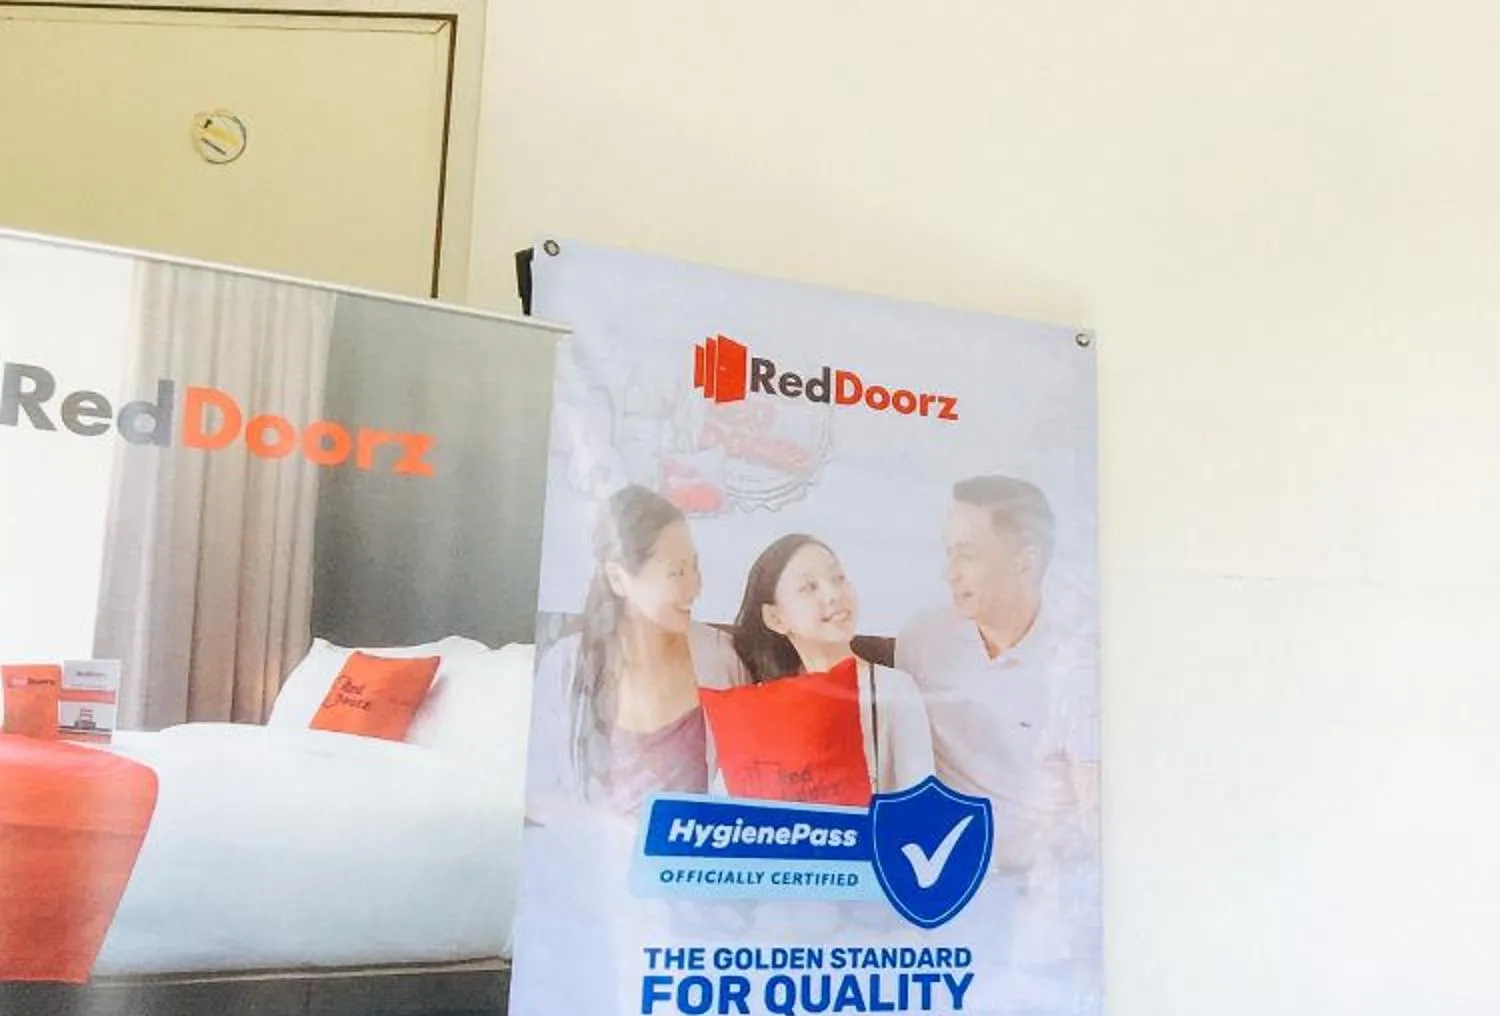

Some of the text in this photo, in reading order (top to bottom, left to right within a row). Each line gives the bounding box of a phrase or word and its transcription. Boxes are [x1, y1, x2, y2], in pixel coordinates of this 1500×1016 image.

[751, 357, 959, 421] RedDoorz
[0, 361, 439, 479] RedDoorz
[668, 818, 859, 848] HygienePass
[659, 870, 860, 888] OFFICIALLY CERTIFIED
[643, 947, 973, 971] THE GOLDEN STANDARD
[640, 972, 975, 1016] FOR QUALITY
